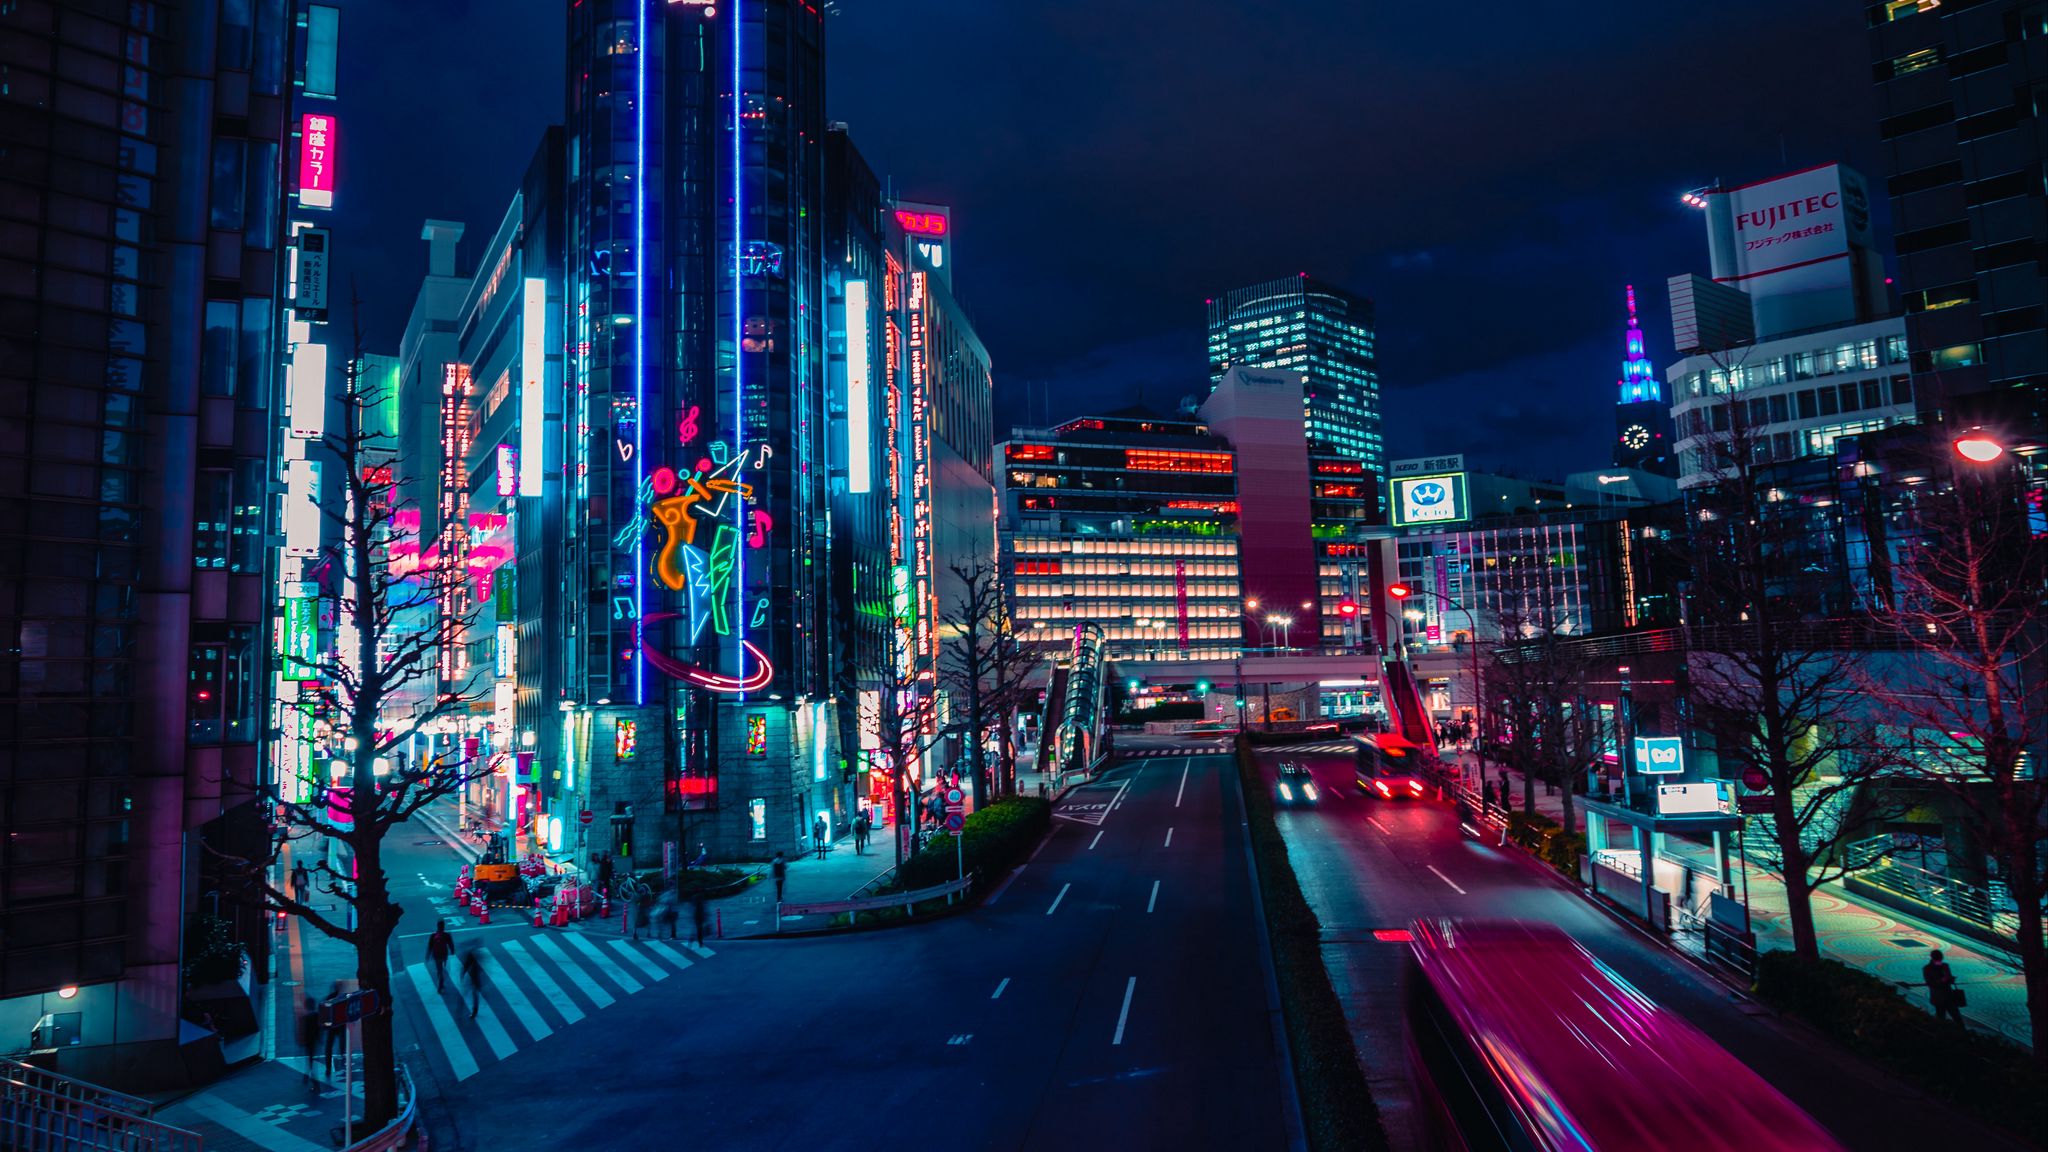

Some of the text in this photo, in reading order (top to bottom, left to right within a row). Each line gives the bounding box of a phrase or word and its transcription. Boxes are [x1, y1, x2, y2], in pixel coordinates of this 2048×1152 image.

[1736, 191, 1839, 231] FUJITEC
[1745, 222, 1834, 251] フジテック株式会社
[1395, 457, 1459, 472] KEIO 新宿駅
